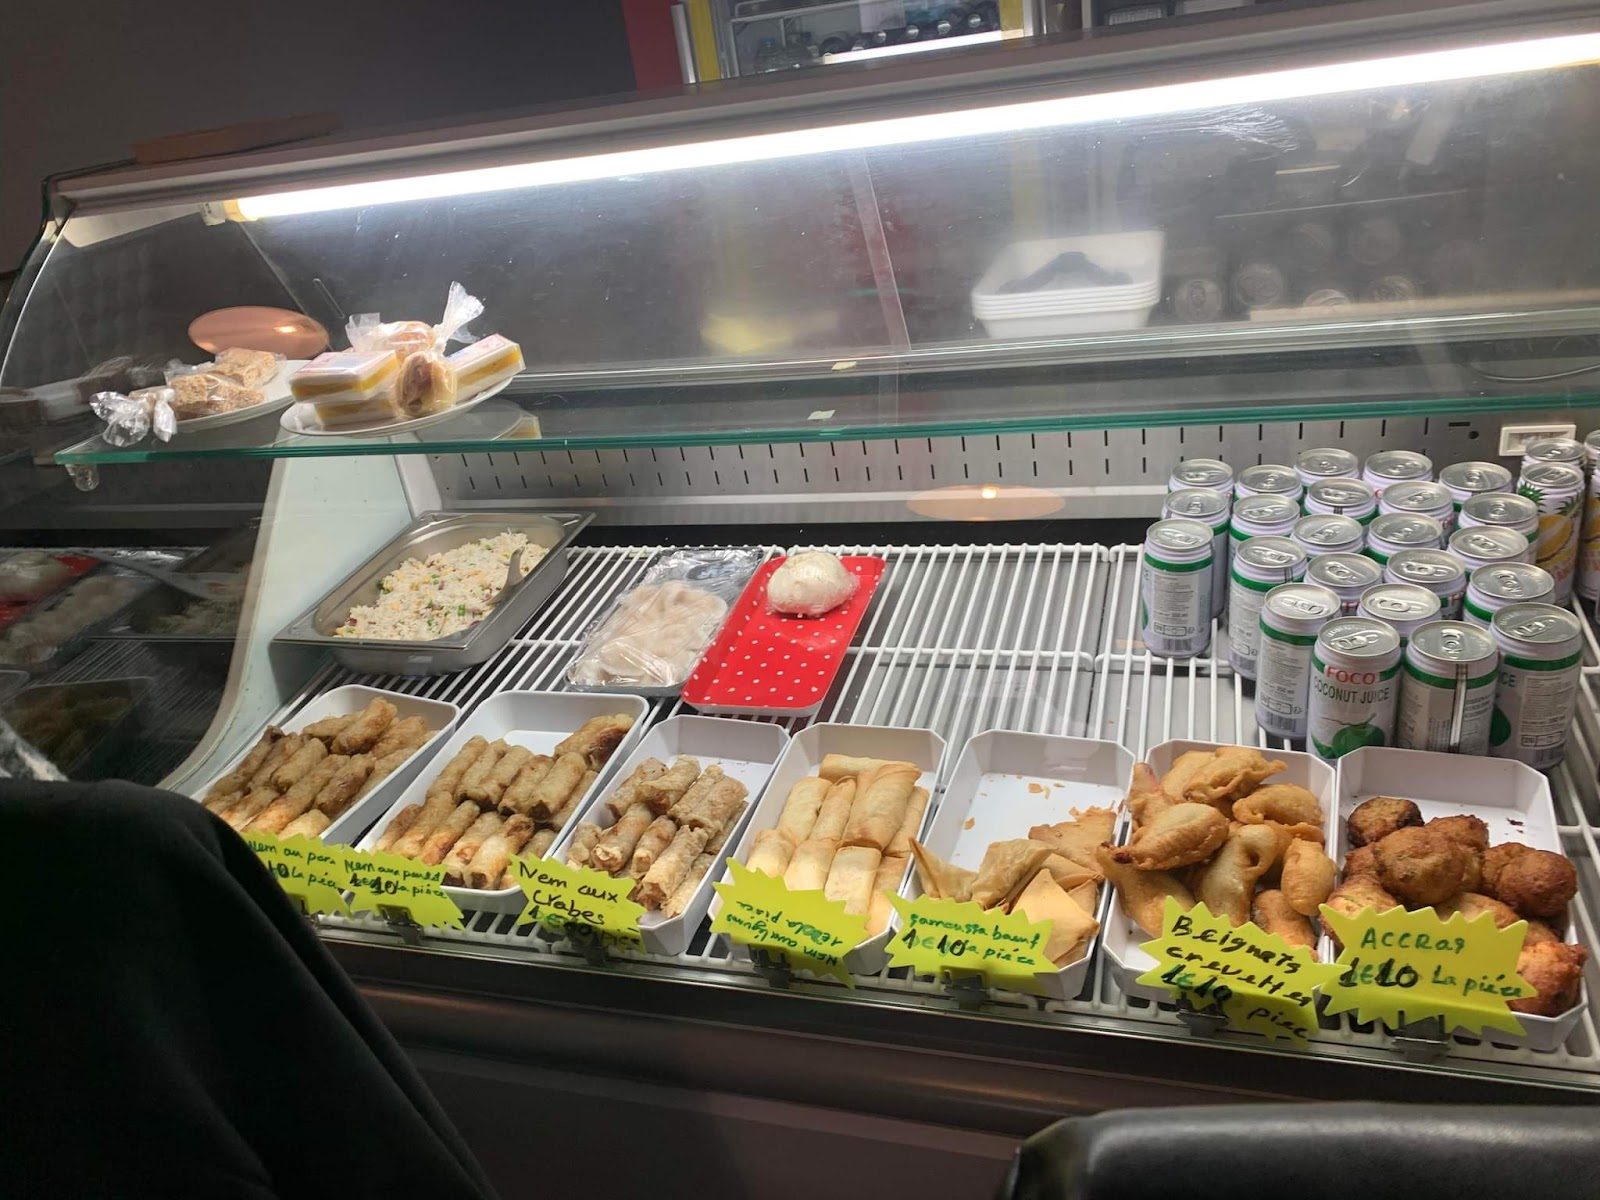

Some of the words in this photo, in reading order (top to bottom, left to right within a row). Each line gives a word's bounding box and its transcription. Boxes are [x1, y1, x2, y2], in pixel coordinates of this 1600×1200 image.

[1314, 676, 1358, 704] COCONUT
[1360, 687, 1390, 704] JUICE
[1326, 666, 1376, 685] FOCO
[344, 859, 375, 874] Nem
[519, 861, 567, 888] Nem
[577, 884, 619, 903] aux
[532, 889, 606, 926] Crabes
[1171, 915, 1302, 974] Beignets
